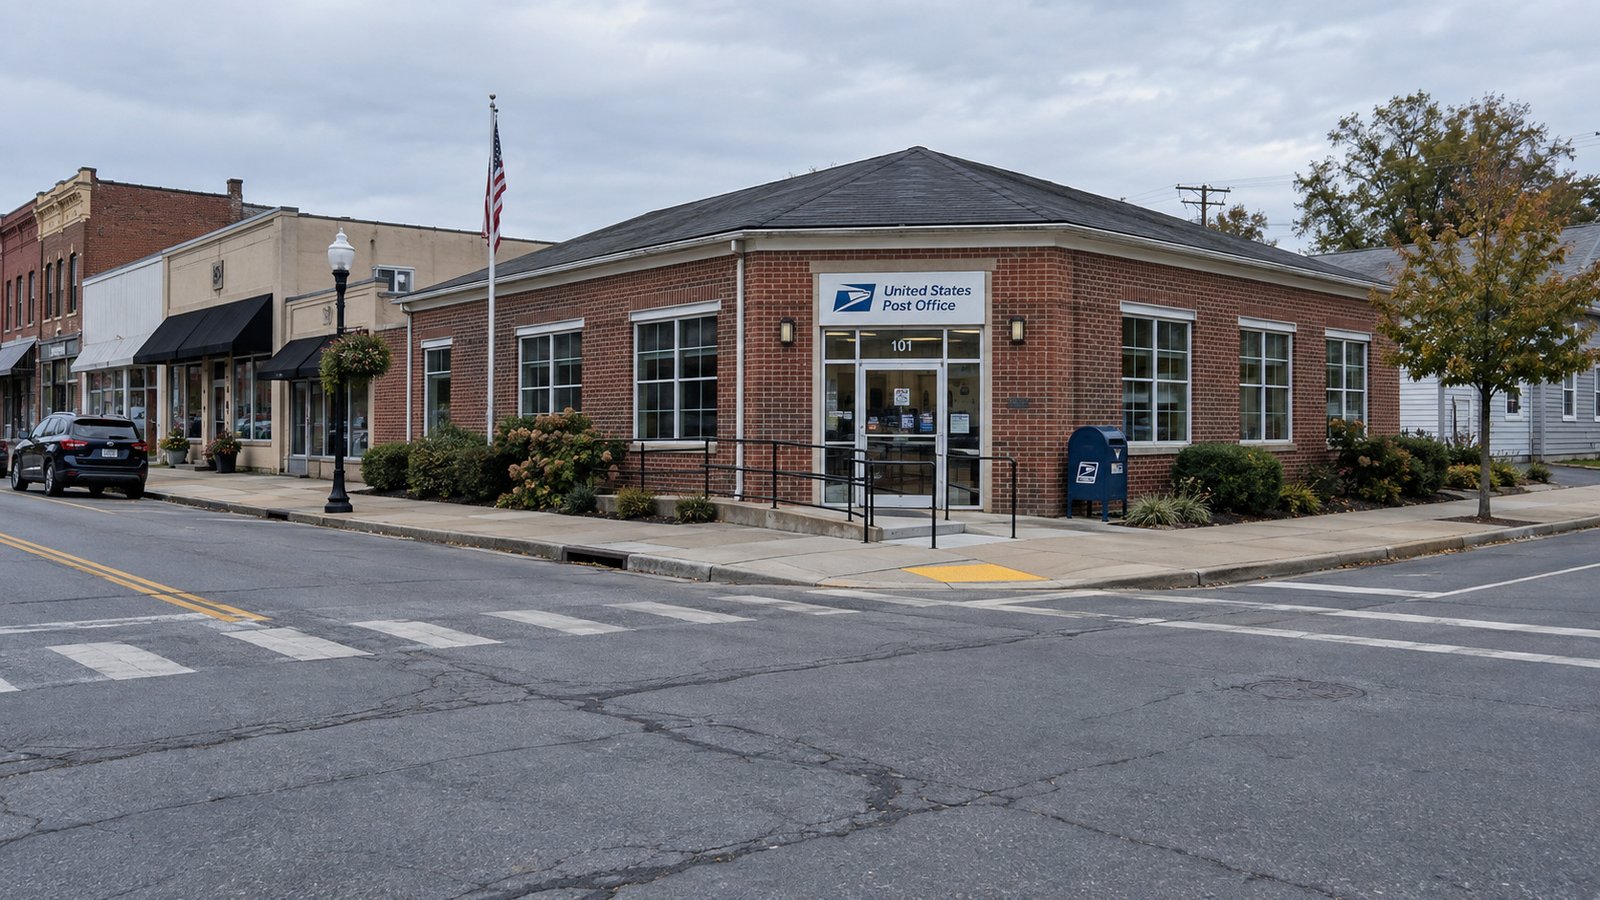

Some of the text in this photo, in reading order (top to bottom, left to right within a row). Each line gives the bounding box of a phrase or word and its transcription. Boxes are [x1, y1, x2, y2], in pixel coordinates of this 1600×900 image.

[885, 285, 971, 296] United States
[882, 299, 956, 311] Post Office
[891, 340, 912, 352] 101
